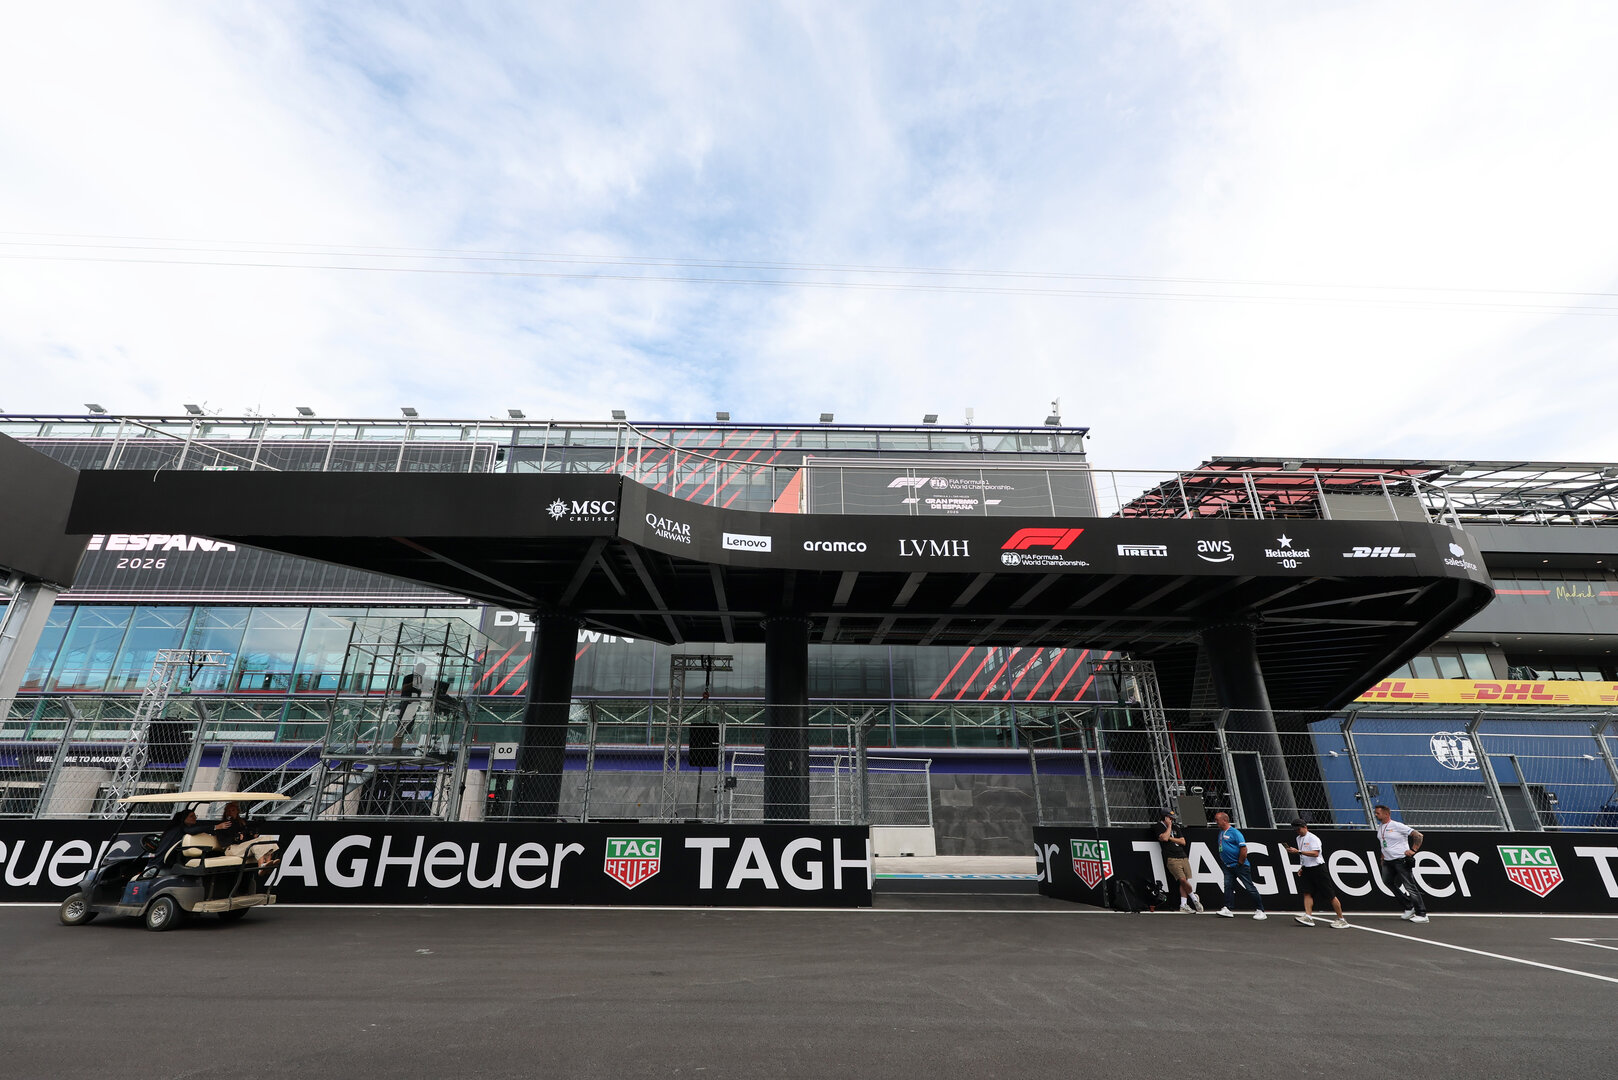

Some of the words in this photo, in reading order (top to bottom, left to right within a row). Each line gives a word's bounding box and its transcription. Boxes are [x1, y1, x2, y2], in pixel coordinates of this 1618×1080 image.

[570, 500, 616, 515] MSC
[645, 513, 691, 536] QATAR
[655, 528, 691, 544] AIRWAYS
[726, 536, 768, 549] Lenovo
[803, 540, 867, 553] aramco
[899, 539, 970, 557] LVMH
[1117, 544, 1168, 557] PIRELLI
[1197, 540, 1232, 552] aws
[1264, 548, 1311, 558] Heineken
[1352, 546, 1406, 558] DHL
[116, 558, 167, 569] 2026
[1444, 557, 1478, 571] salesforce
[1556, 584, 1596, 601] Madrid
[1362, 682, 1414, 699] HL
[1473, 683, 1554, 700] DHL
[611, 841, 656, 856] TAG
[1073, 842, 1106, 859] TAG
[261, 834, 585, 889] AGHeuer
[1503, 849, 1552, 865] TAG
[607, 861, 657, 885] HEUER
[1074, 860, 1110, 885] HEUER
[1509, 869, 1560, 893] HEUER
